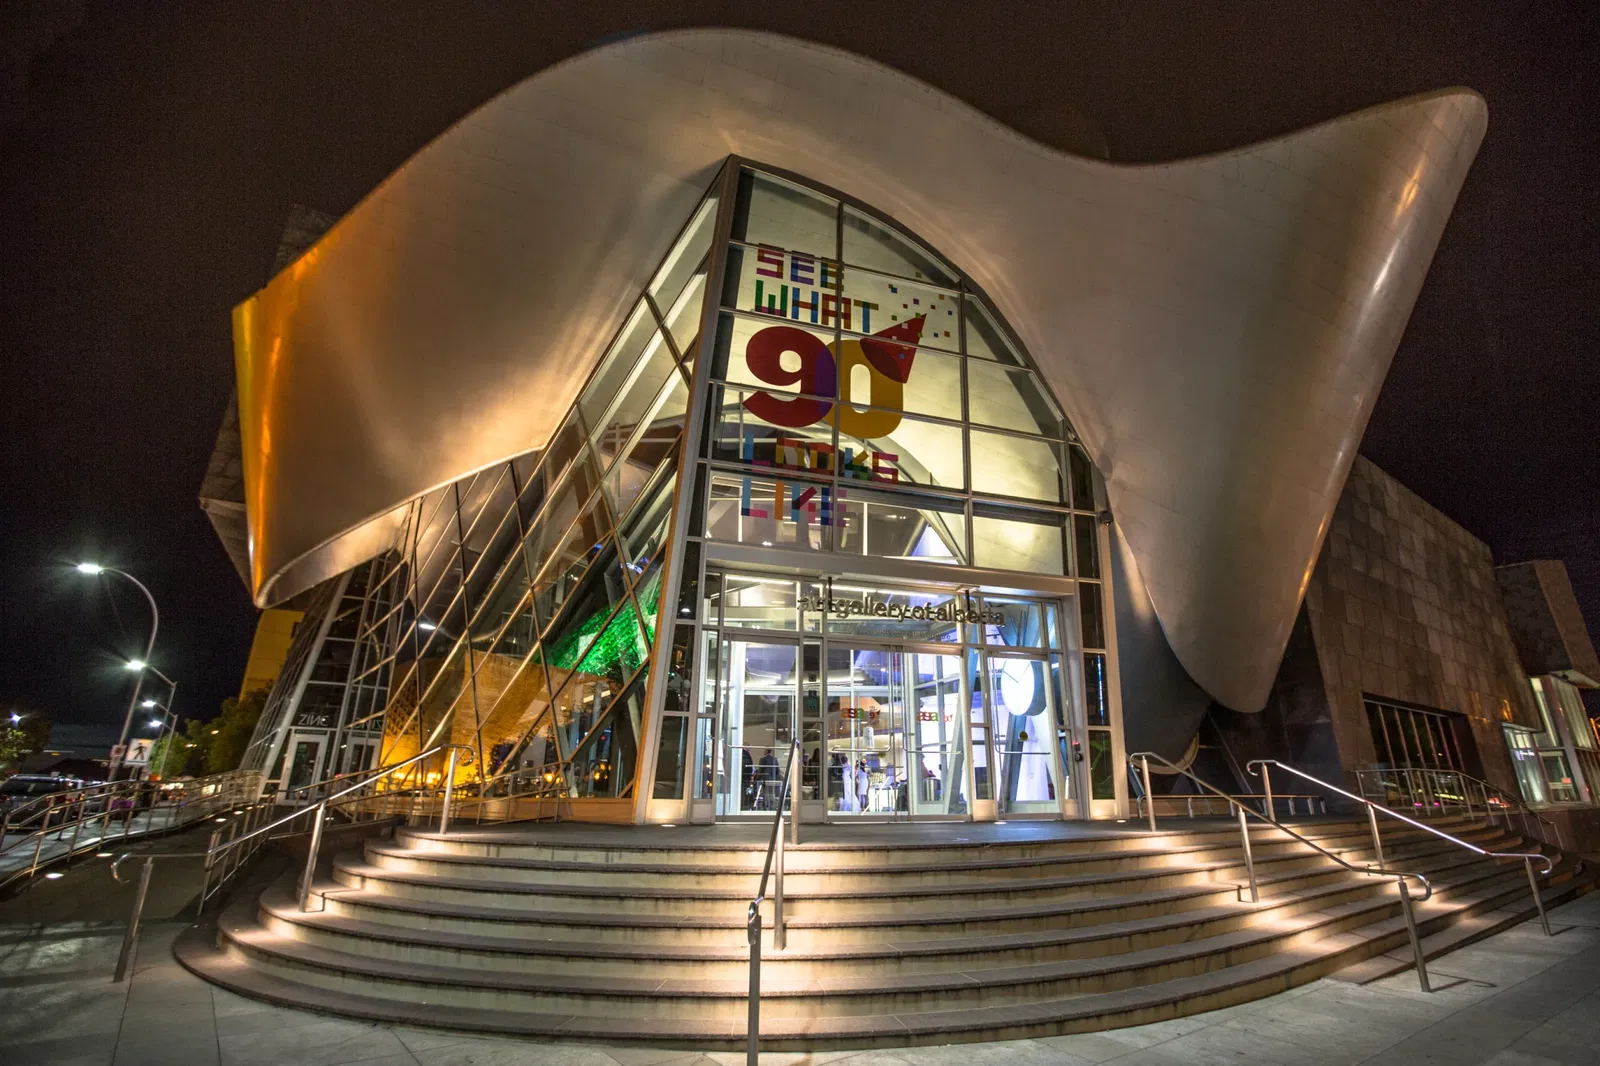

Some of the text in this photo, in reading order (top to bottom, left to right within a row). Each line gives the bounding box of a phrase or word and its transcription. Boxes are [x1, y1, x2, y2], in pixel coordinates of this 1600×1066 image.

[756, 243, 845, 291] SEE
[754, 279, 879, 334] WHAT
[741, 325, 904, 439] 90
[743, 432, 899, 490] LOOKS
[741, 476, 847, 528] LIKE
[835, 596, 907, 622] gallery
[911, 602, 932, 621] of
[935, 603, 1005, 626] alberta
